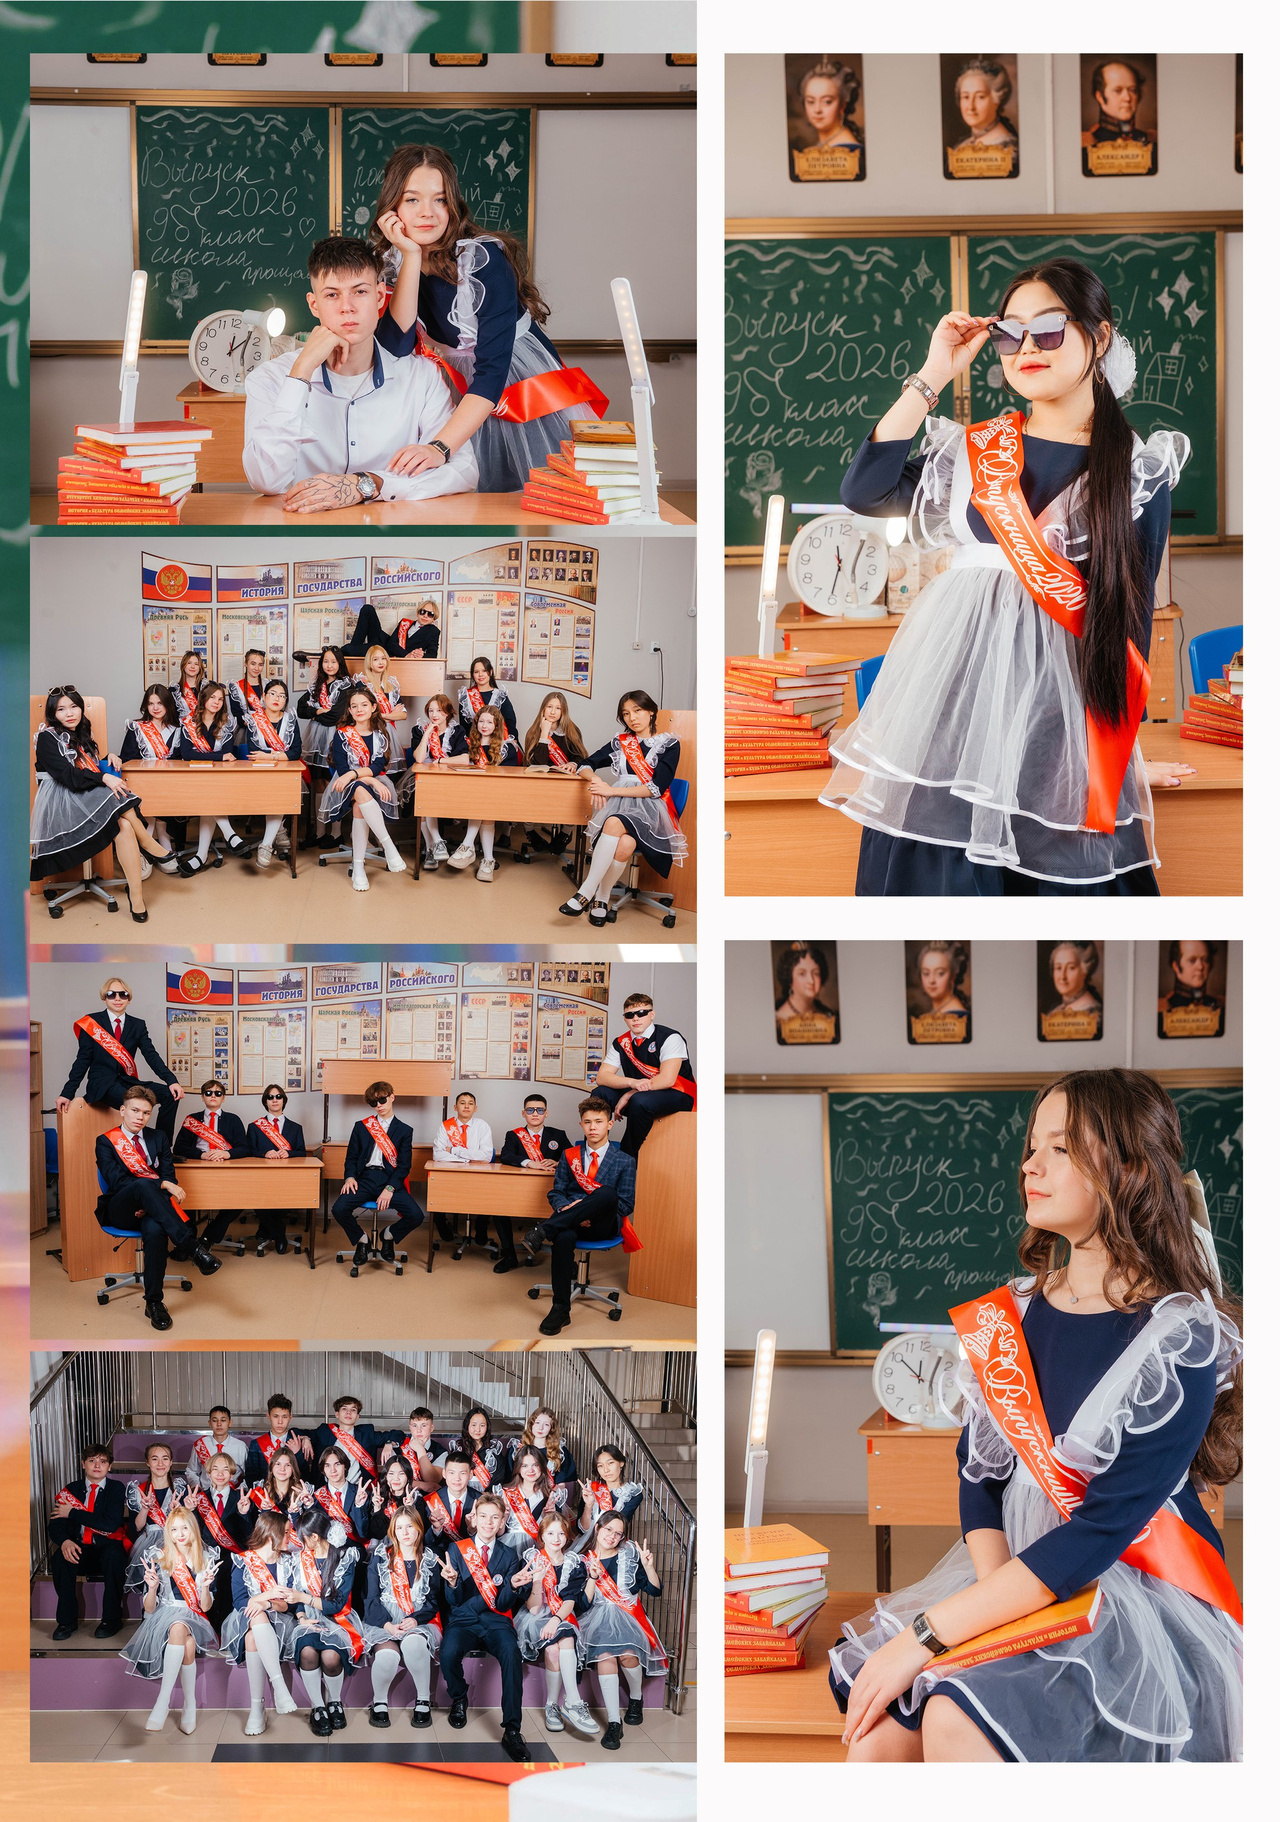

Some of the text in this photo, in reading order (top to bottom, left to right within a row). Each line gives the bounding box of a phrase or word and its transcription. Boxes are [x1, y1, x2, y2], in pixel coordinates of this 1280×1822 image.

[141, 146, 265, 205] Выпуск
[218, 187, 297, 217] 2026
[200, 227, 275, 248] класс
[151, 247, 253, 267] школа
[218, 319, 227, 330] 11
[231, 318, 242, 329] 12
[206, 328, 217, 338] 10
[199, 341, 208, 351] 9
[252, 336, 261, 347] 2
[200, 356, 209, 366] 8
[253, 351, 261, 361] 3
[806, 339, 912, 383] 2026
[209, 368, 217, 378] 7
[220, 374, 229, 384] 6
[824, 526, 833, 538] 11
[840, 523, 852, 536] 12
[809, 536, 822, 549] 10
[866, 546, 876, 558] 2
[800, 554, 811, 565] 9
[867, 564, 877, 576] 3
[802, 572, 813, 584] 8
[241, 571, 441, 598] ИСТОРИЯ ГОСУДАРСТВА РОССИЙСКОГО
[859, 582, 869, 592] 4
[813, 587, 823, 598] 7
[827, 594, 837, 606] 6
[261, 974, 455, 1001] ИСТОРИЯ ГОСУДАРСТВА РОССИЙСКОГО
[834, 1138, 969, 1202] Выпуск
[917, 1180, 1006, 1216] 2026
[898, 1226, 980, 1249] класс
[846, 1248, 956, 1270] школа
[905, 1342, 914, 1353] 11
[919, 1341, 931, 1352] 12
[891, 1352, 903, 1363] 10
[944, 1361, 953, 1371] 2
[884, 1367, 893, 1378] 9
[885, 1384, 895, 1394] 8
[895, 1397, 904, 1407] 7
[908, 1403, 917, 1414] 6
[1016, 1635, 1045, 1649] КУЛЬТУРА
